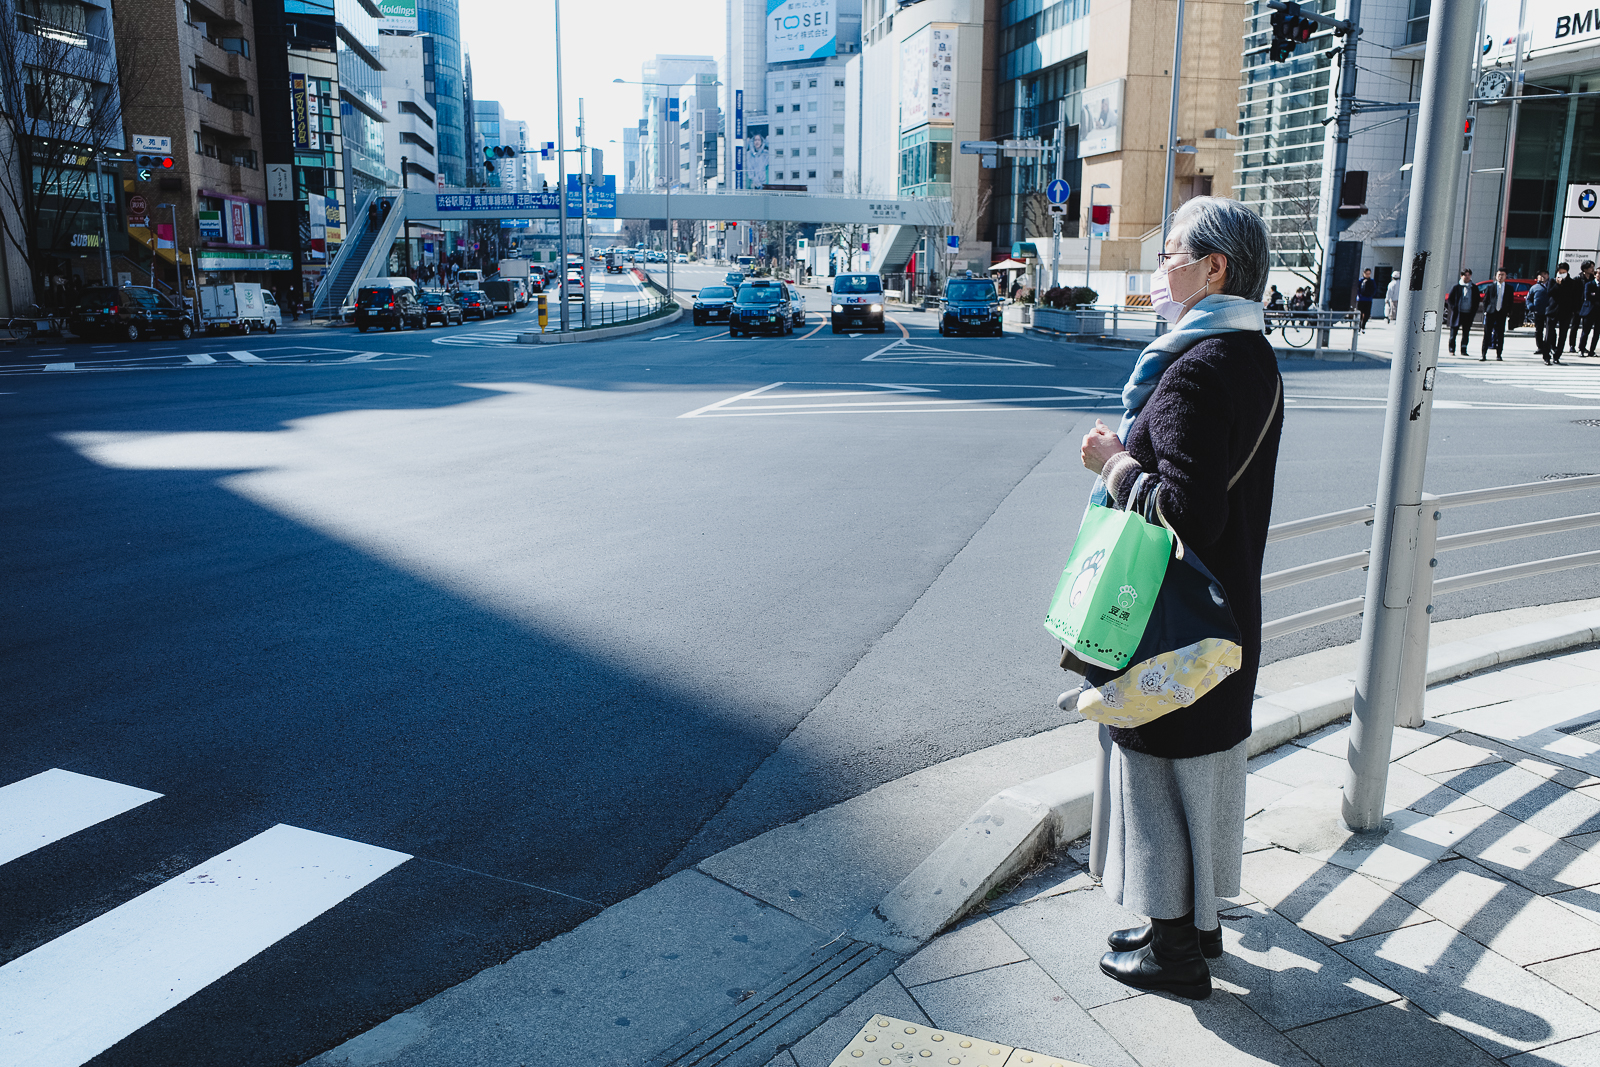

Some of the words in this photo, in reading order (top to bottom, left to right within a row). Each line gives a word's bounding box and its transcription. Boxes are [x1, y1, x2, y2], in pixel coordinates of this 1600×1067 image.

[380, 5, 415, 16] Holdings
[774, 11, 829, 31] TOSEI
[1555, 8, 1600, 39] BM
[135, 137, 169, 147] 外苑前
[438, 195, 472, 207] 渋谷駅周辺
[70, 233, 103, 247] SUBWA
